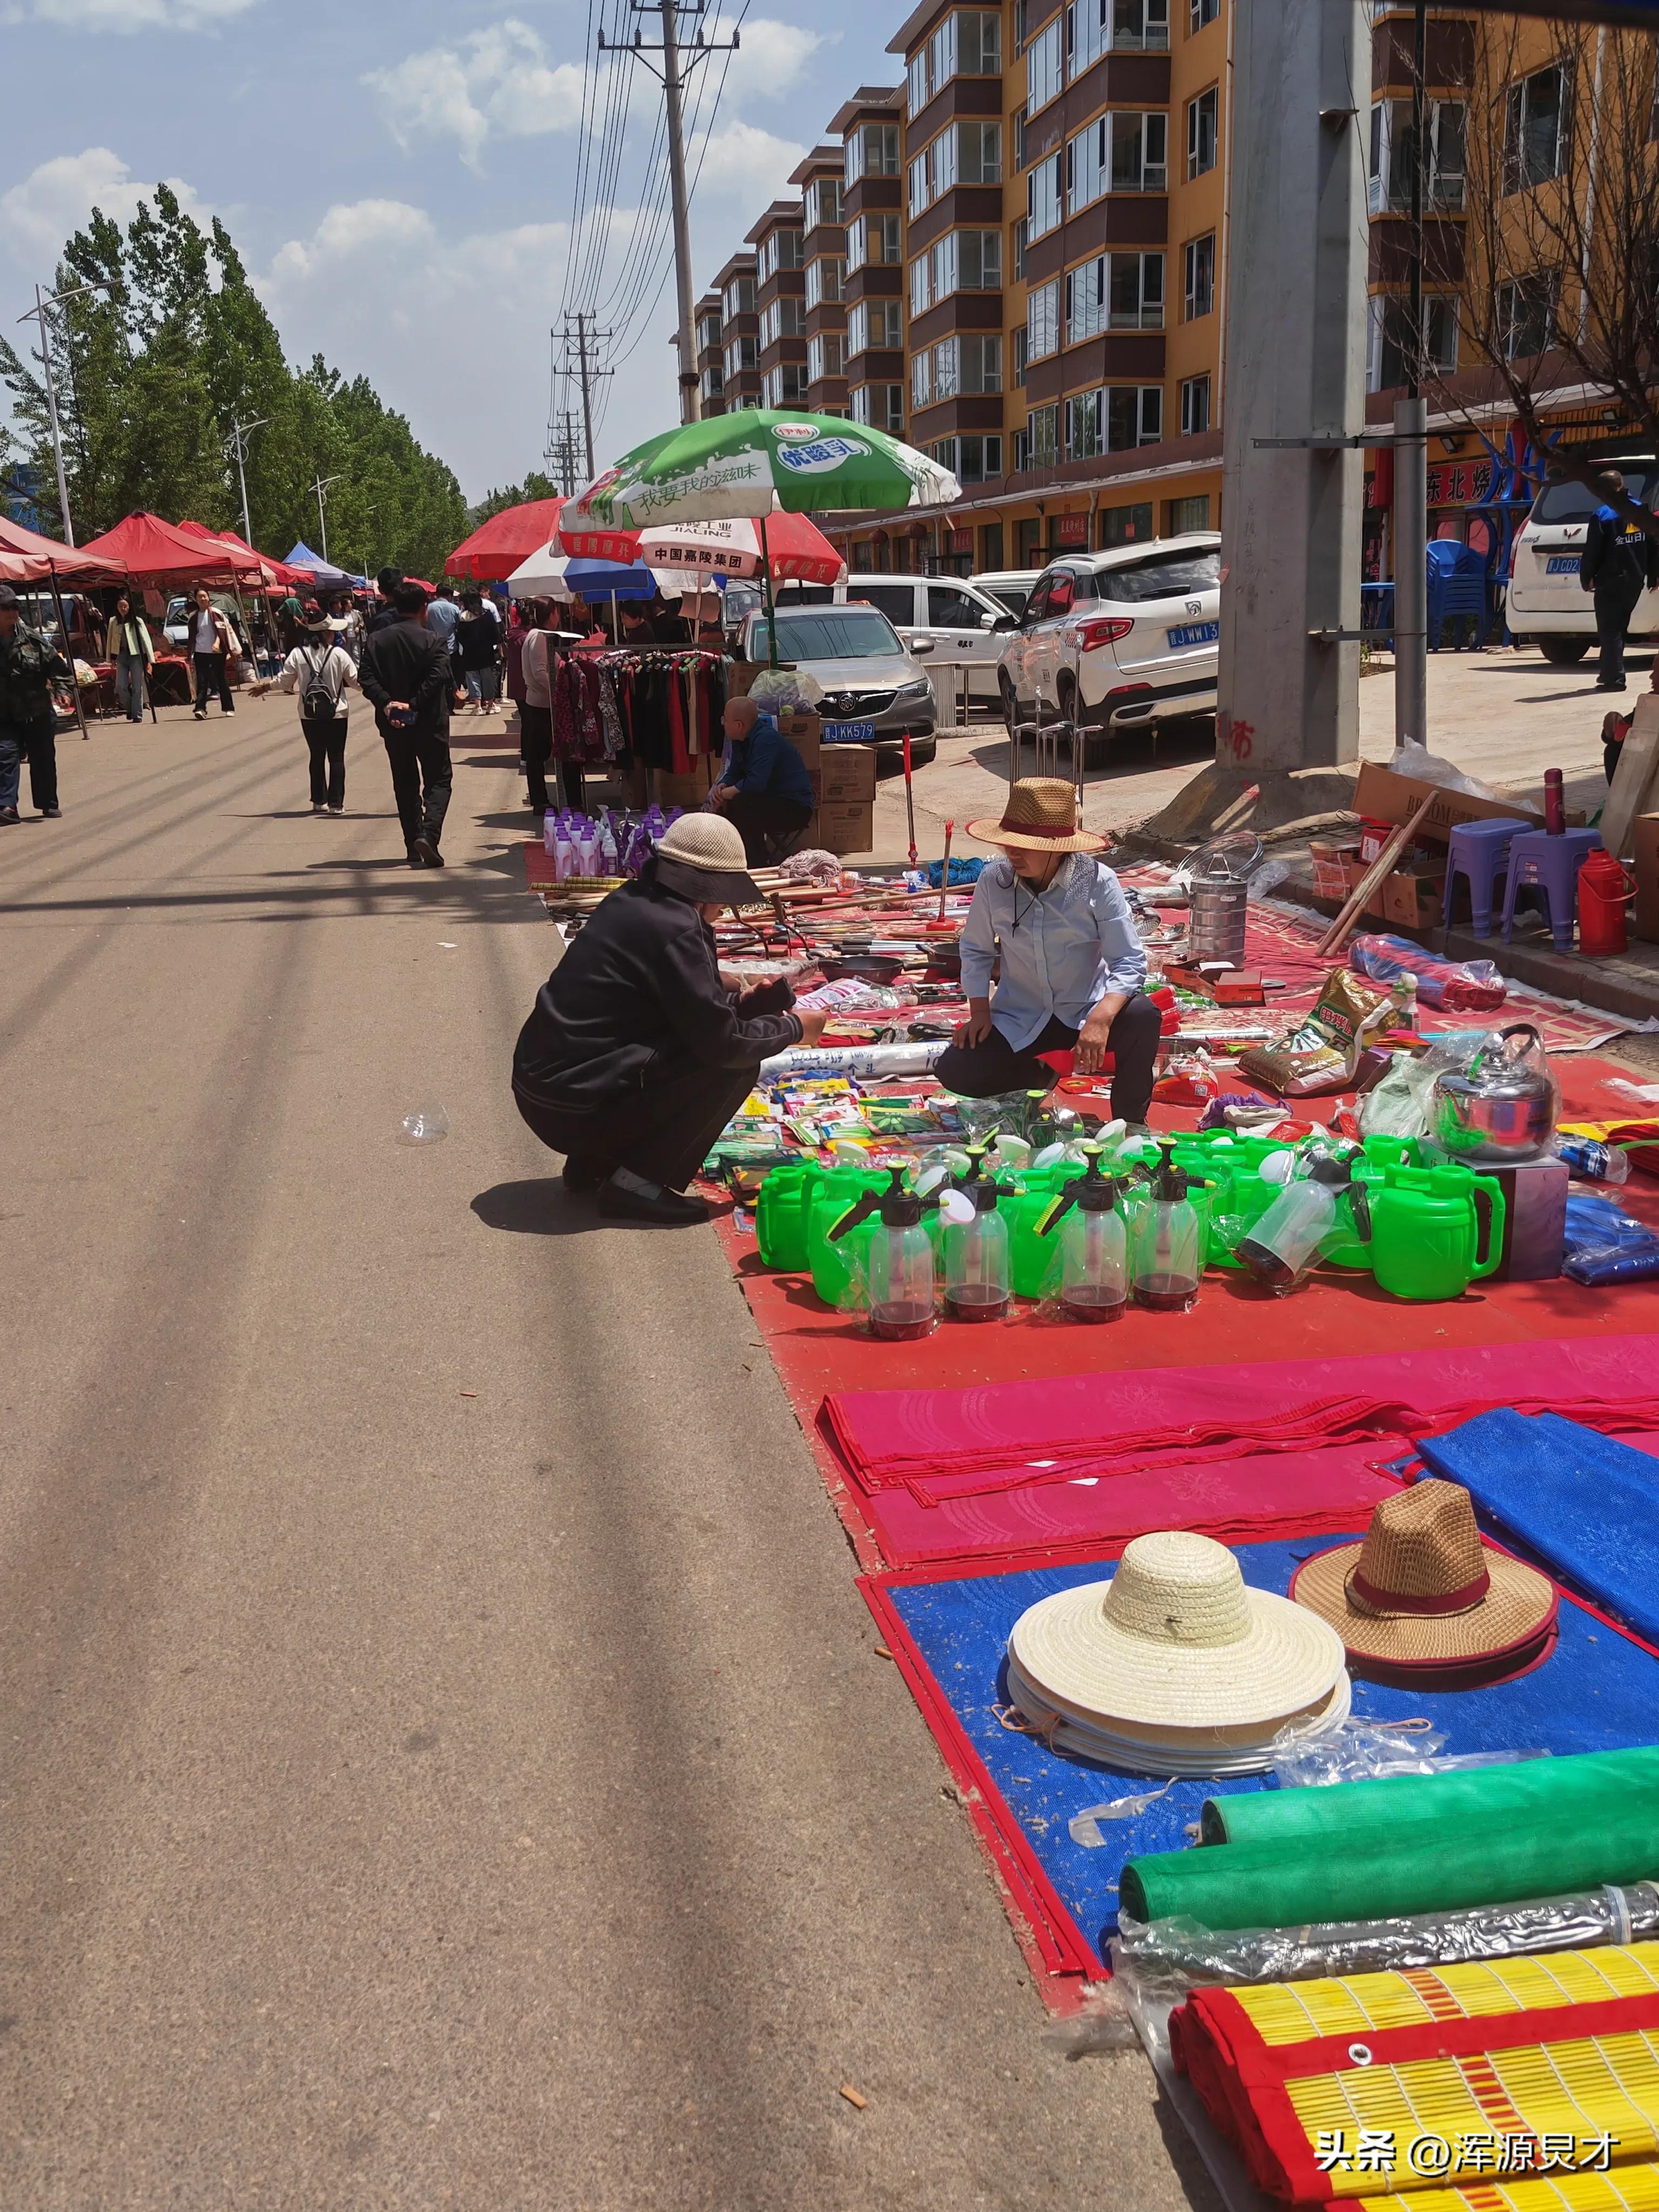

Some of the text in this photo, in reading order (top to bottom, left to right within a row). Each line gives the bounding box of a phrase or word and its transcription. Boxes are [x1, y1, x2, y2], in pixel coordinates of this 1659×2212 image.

[778, 427, 811, 436] 伊利
[781, 439, 858, 467] 优酸乳
[632, 462, 761, 516] 我要我的滋味
[1426, 464, 1513, 504] 东北烧
[670, 527, 731, 538] JIALING
[655, 548, 742, 569] 中国嘉陵集团
[1548, 558, 1581, 572] JCD2
[1407, 795, 1452, 824] BROM
